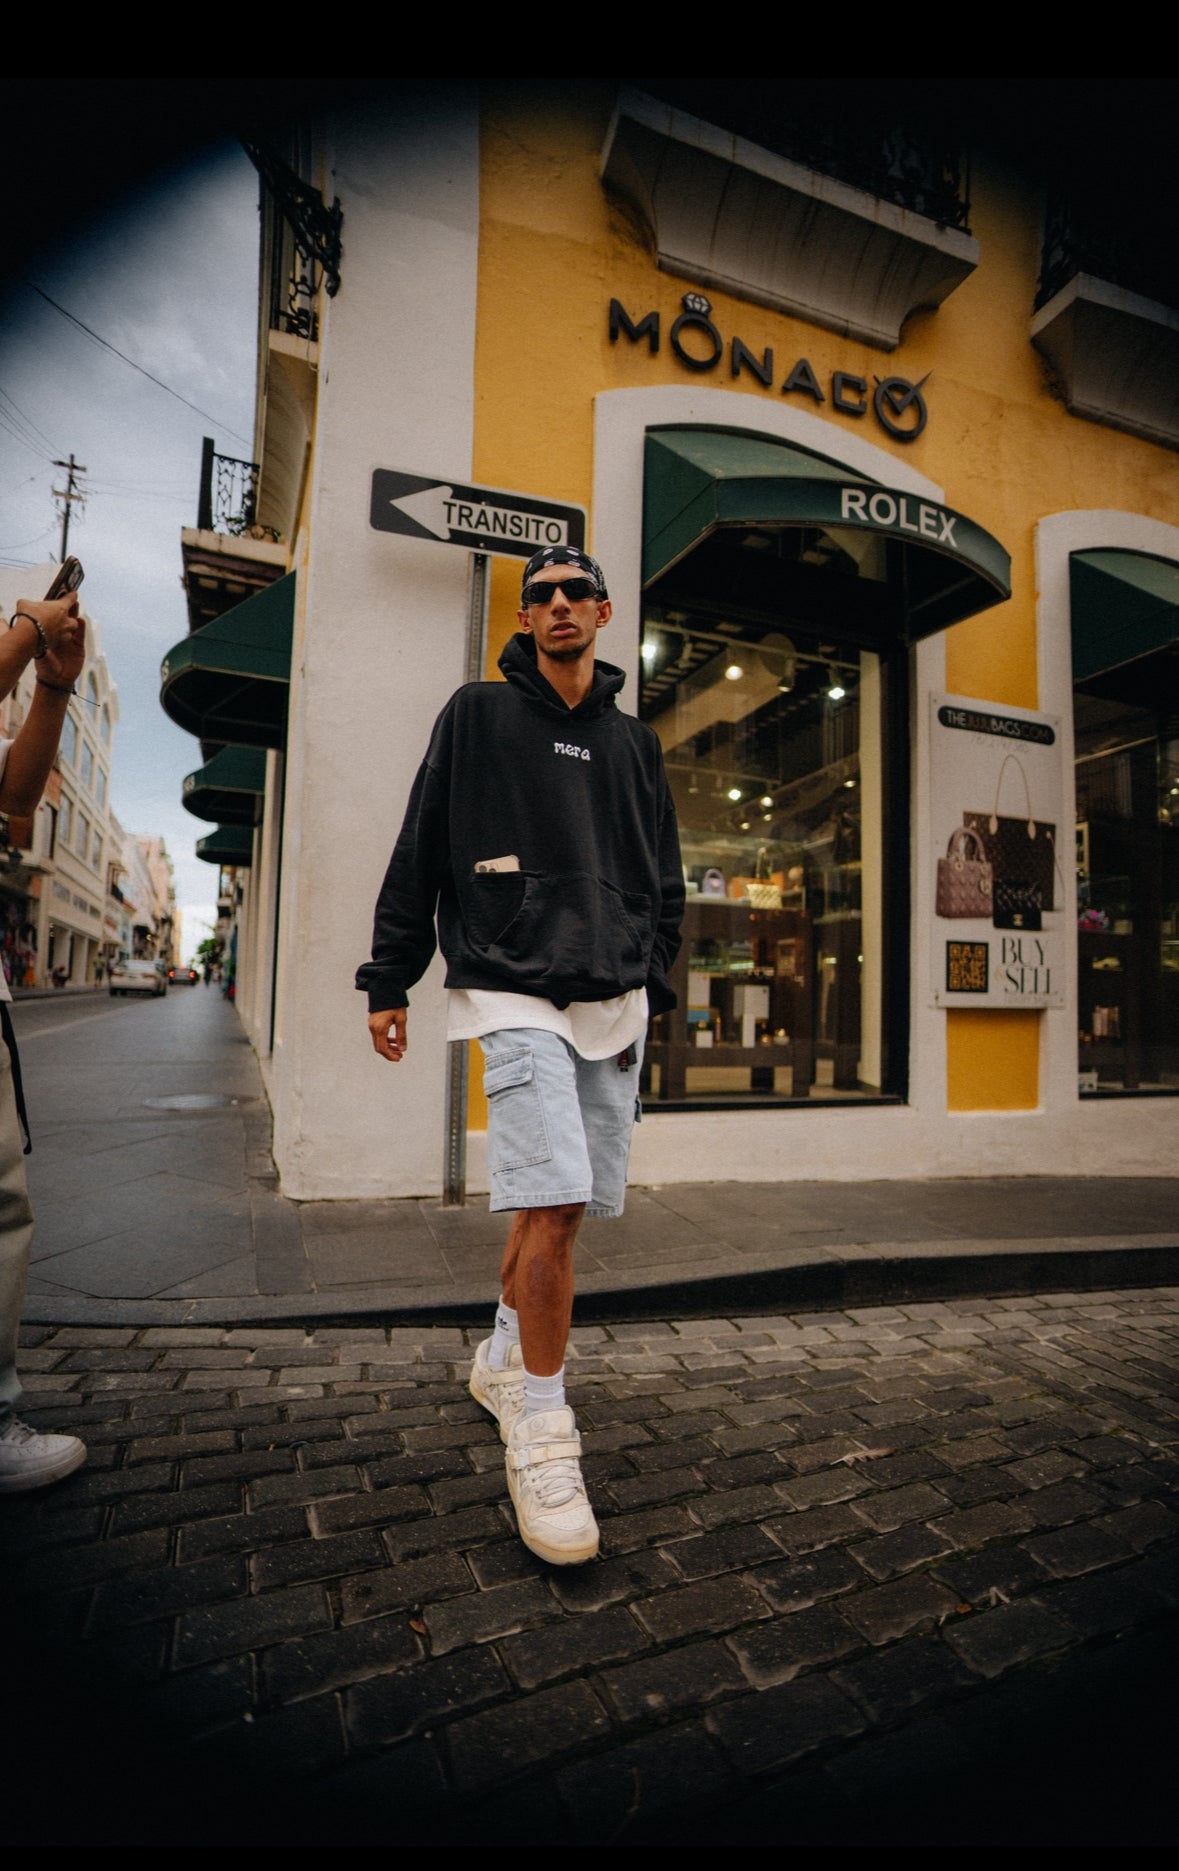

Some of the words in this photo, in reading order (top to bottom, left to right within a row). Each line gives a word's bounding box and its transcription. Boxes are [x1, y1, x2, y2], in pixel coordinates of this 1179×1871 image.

[609, 292, 931, 442] MONACO
[841, 487, 957, 548] ROLEX
[554, 742, 591, 761] mera
[1001, 937, 1048, 966] BUY
